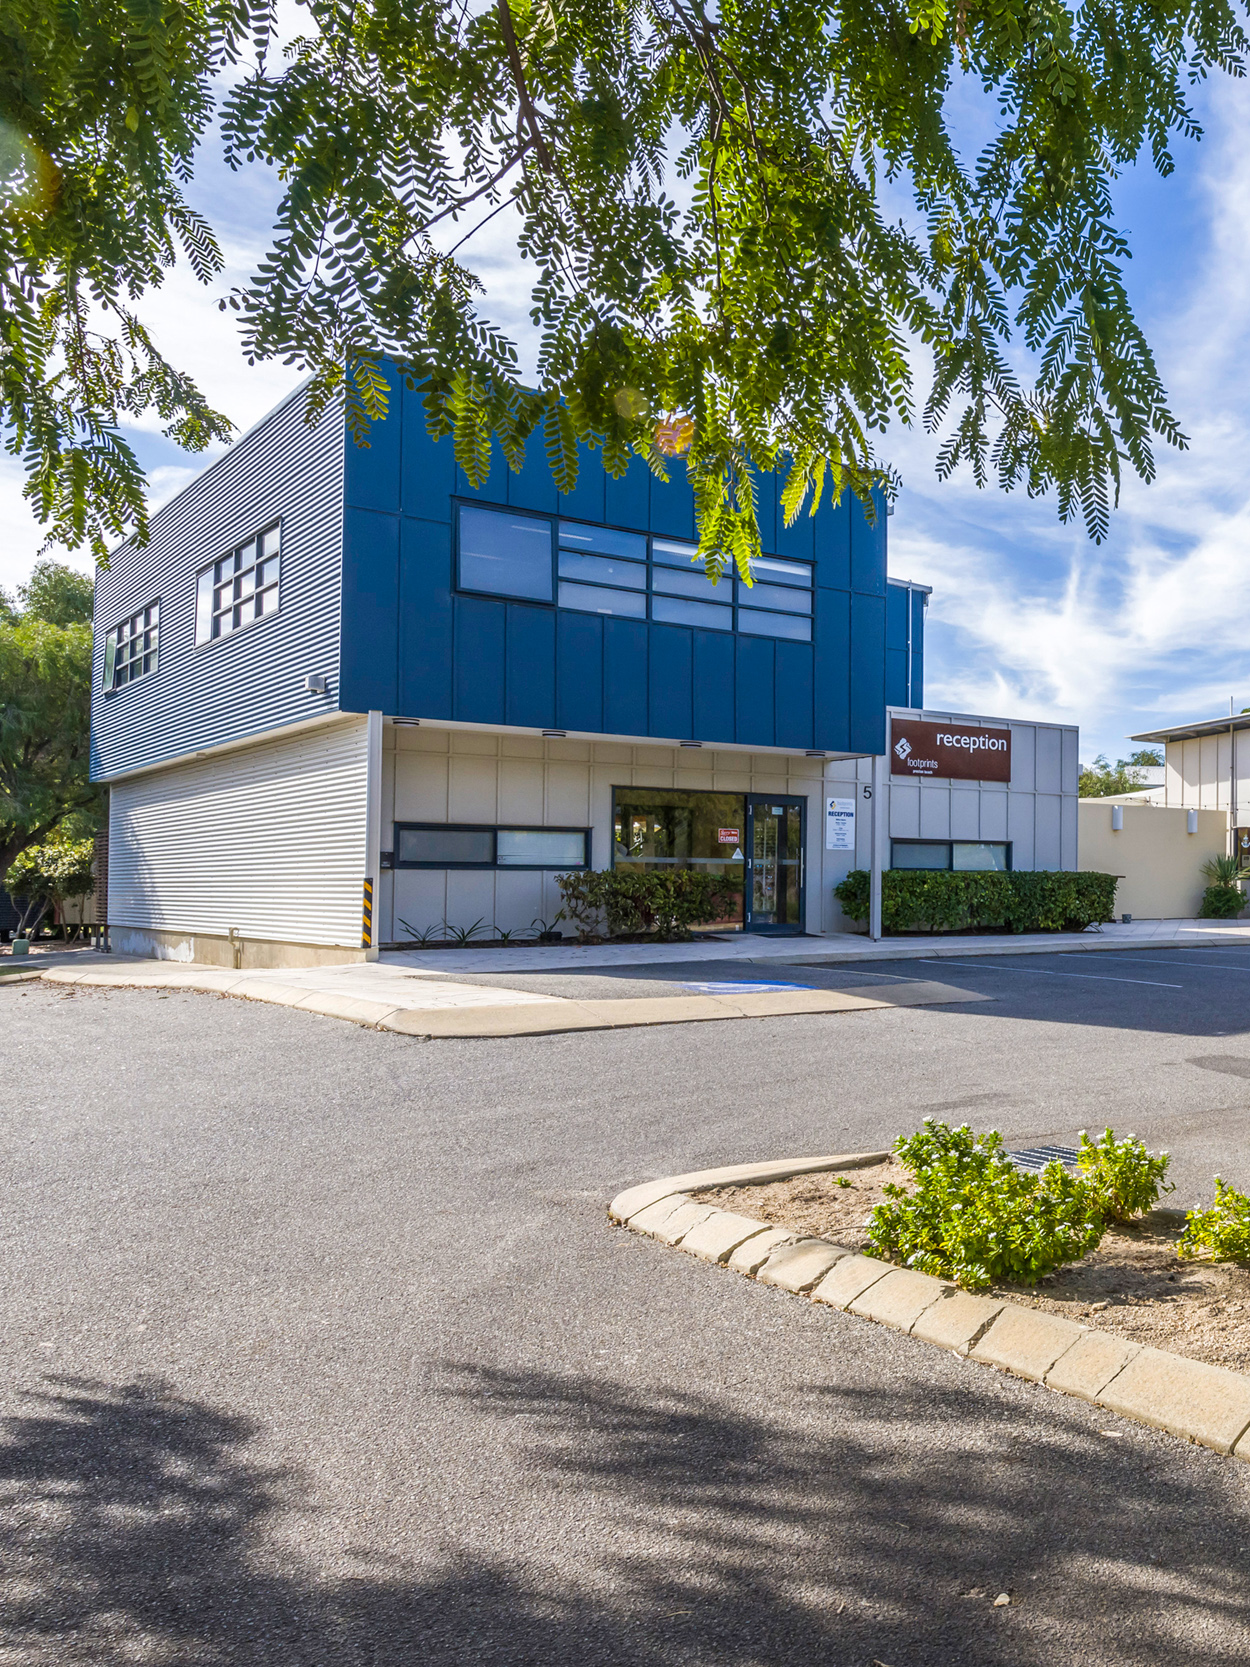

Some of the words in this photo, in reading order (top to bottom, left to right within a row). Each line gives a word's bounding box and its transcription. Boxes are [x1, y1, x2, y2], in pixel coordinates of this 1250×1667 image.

[936, 733, 1007, 753] reception
[907, 757, 938, 769] footprints
[863, 785, 873, 799] 5
